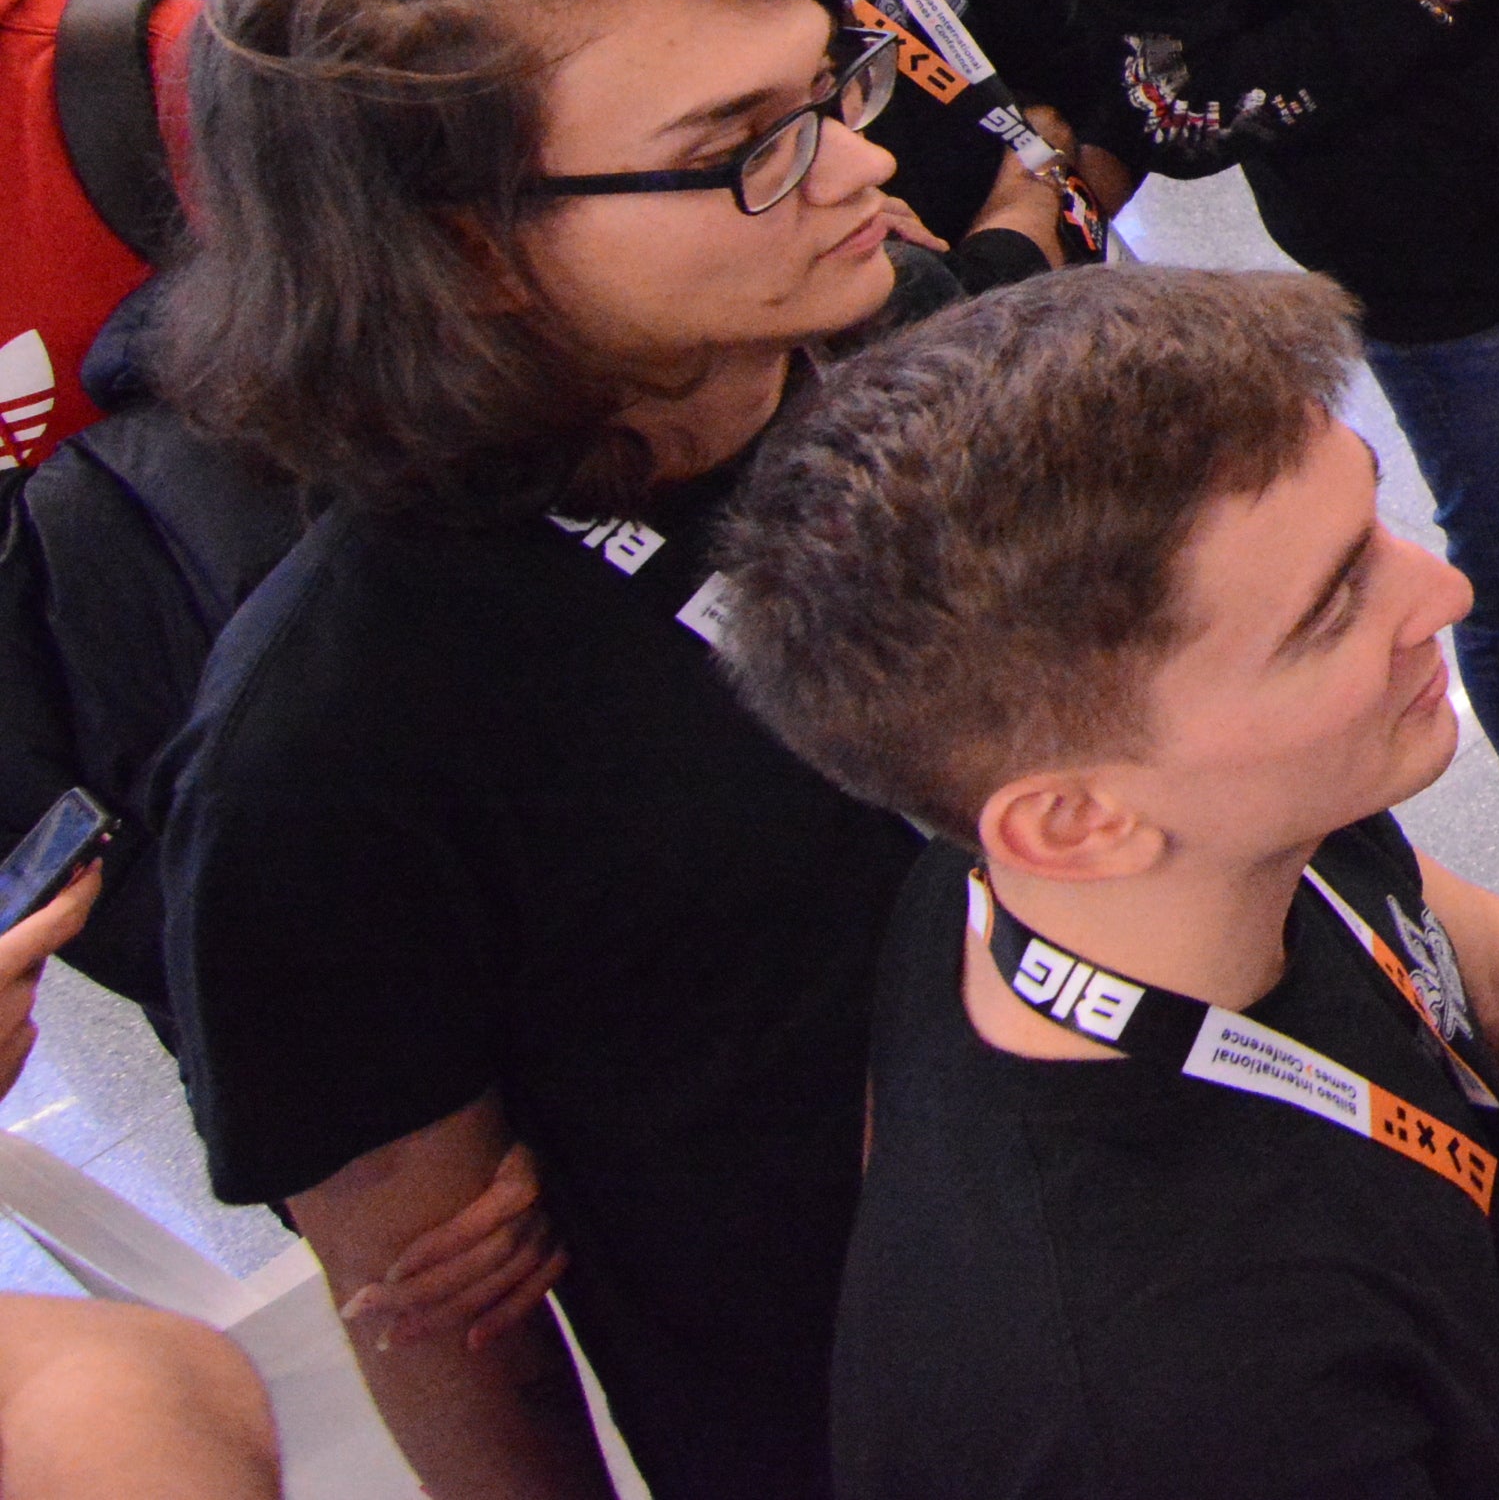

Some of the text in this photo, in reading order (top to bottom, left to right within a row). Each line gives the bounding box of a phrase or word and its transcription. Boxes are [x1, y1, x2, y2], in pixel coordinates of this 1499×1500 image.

[934, 23, 972, 75] Conference
[937, 12, 982, 70] International
[1012, 937, 1145, 1042] BIG
[1212, 1047, 1357, 1116] Bilbao International
[1220, 1028, 1357, 1100] Games Conference
